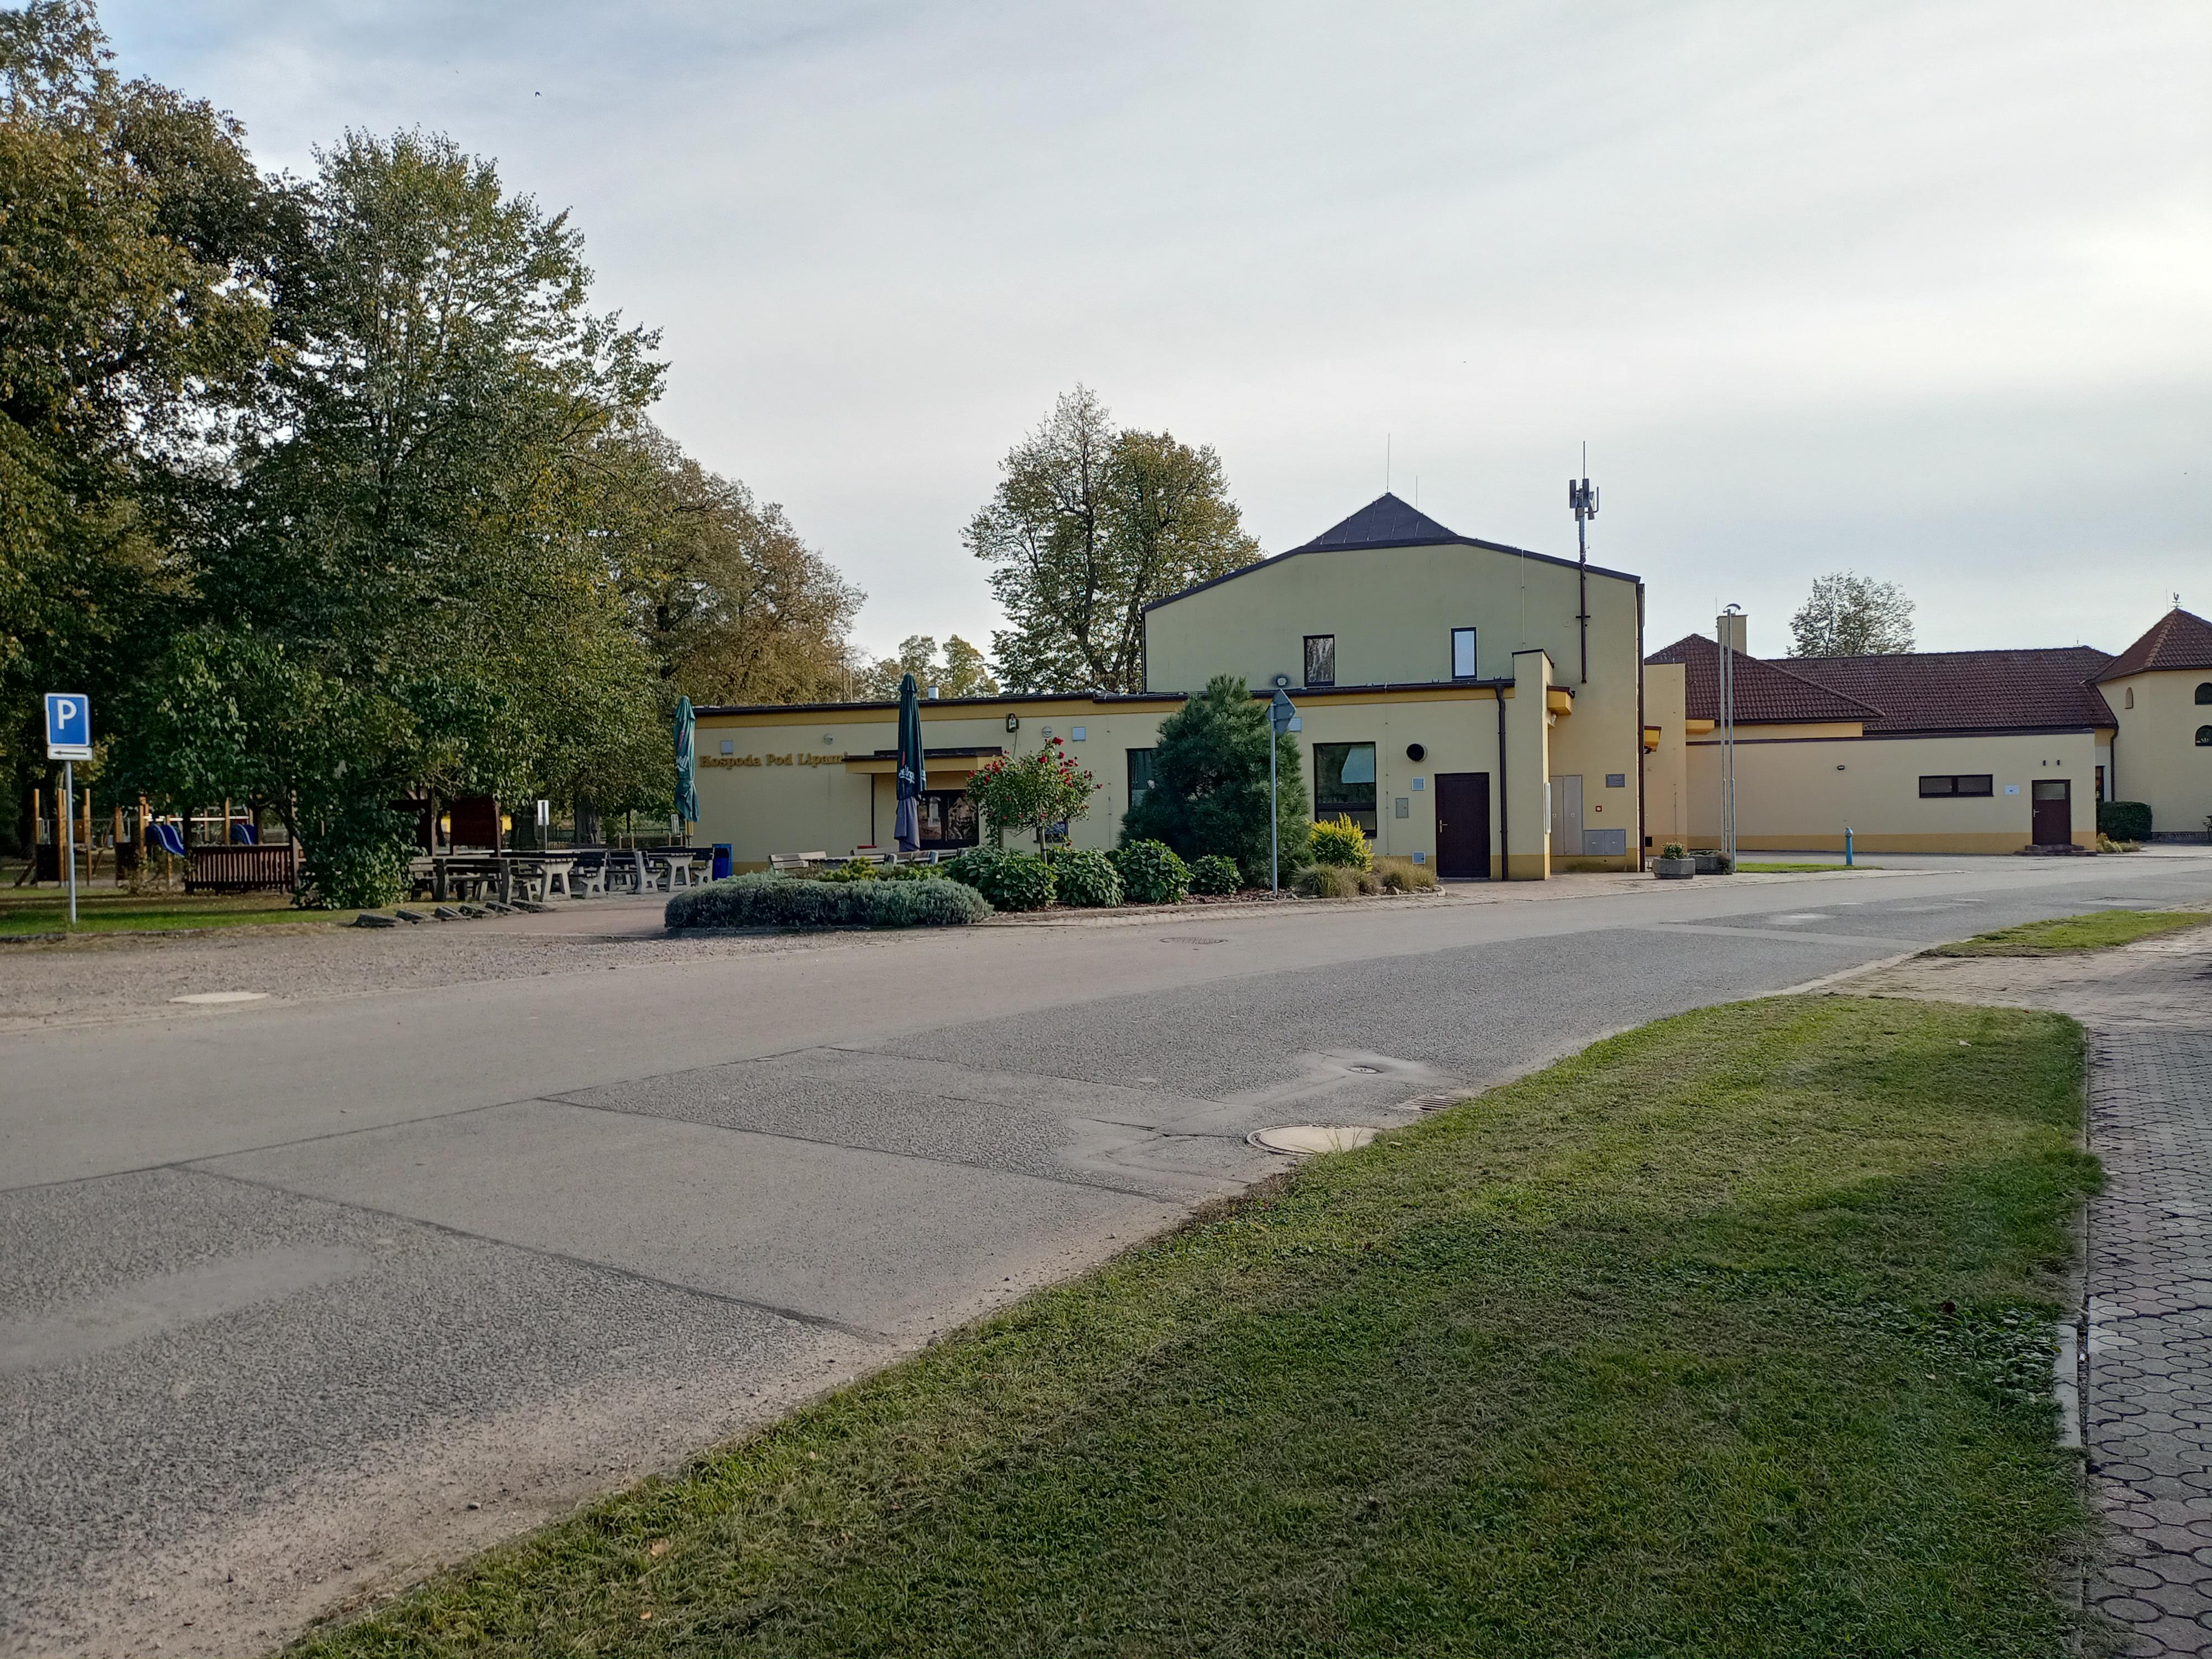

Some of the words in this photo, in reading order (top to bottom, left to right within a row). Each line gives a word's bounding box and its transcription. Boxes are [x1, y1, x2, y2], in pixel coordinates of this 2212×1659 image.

[58, 699, 76, 729] P
[700, 754, 761, 769] Hospoda
[766, 753, 793, 766] Pod
